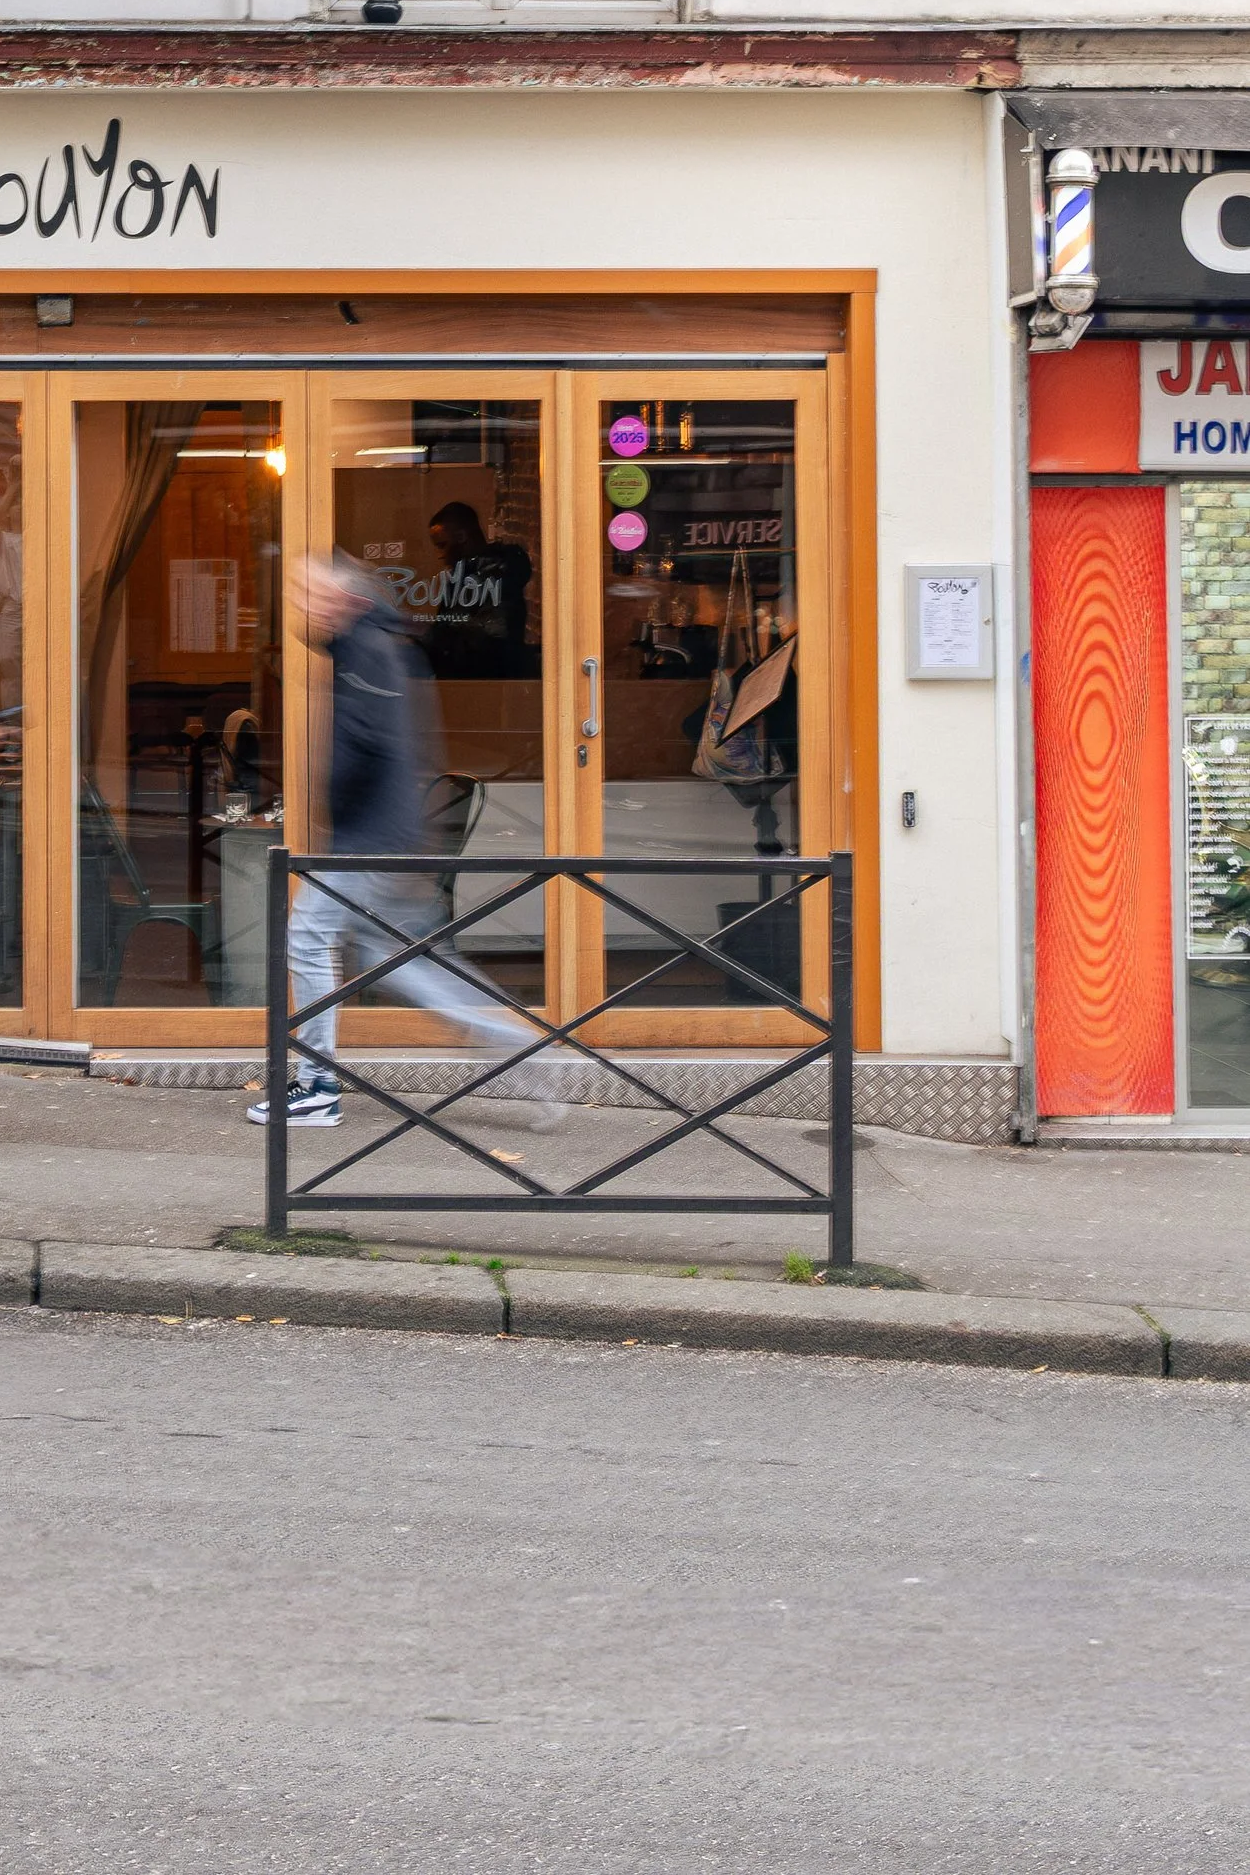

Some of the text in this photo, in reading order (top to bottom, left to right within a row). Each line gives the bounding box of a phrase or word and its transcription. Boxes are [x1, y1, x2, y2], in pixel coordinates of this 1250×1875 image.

[1156, 339, 1250, 396] JA
[612, 432, 645, 444] 2025
[412, 613, 471, 622] BELLEVILLE
